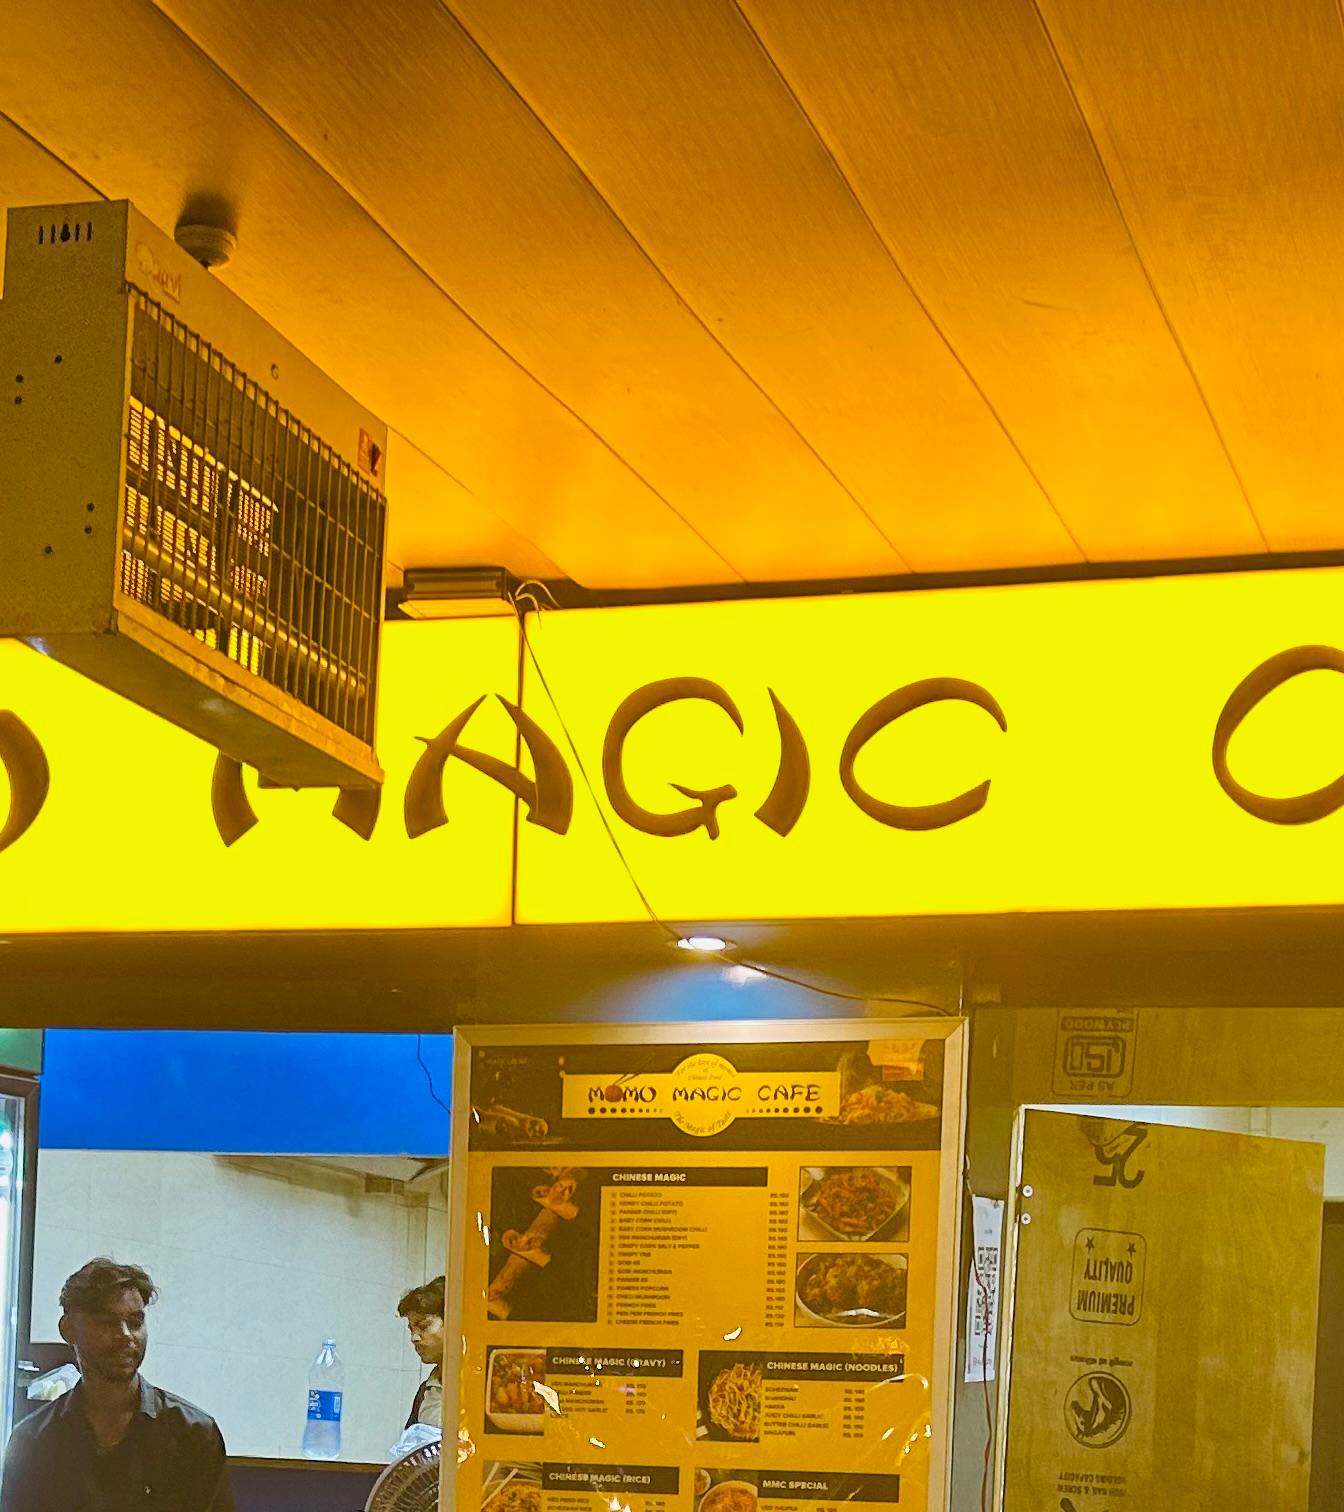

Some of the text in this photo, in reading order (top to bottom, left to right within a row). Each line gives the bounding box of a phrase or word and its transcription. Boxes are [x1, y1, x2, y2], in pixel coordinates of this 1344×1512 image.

[672, 1086, 742, 1101] MAGIC
[758, 1084, 821, 1101] CAFE
[612, 1173, 687, 1182] CHINESE MAGIC
[1085, 1257, 1133, 1284] QUALITY
[1076, 1293, 1135, 1316] PREMIUM
[552, 1357, 592, 1365] CHINE
[767, 1362, 898, 1372] CHINESE MAGIC (NOODLES)
[549, 1472, 651, 1484] CHINESE MAGIC (RICE)
[763, 1480, 828, 1490] MMC SPECIAL
